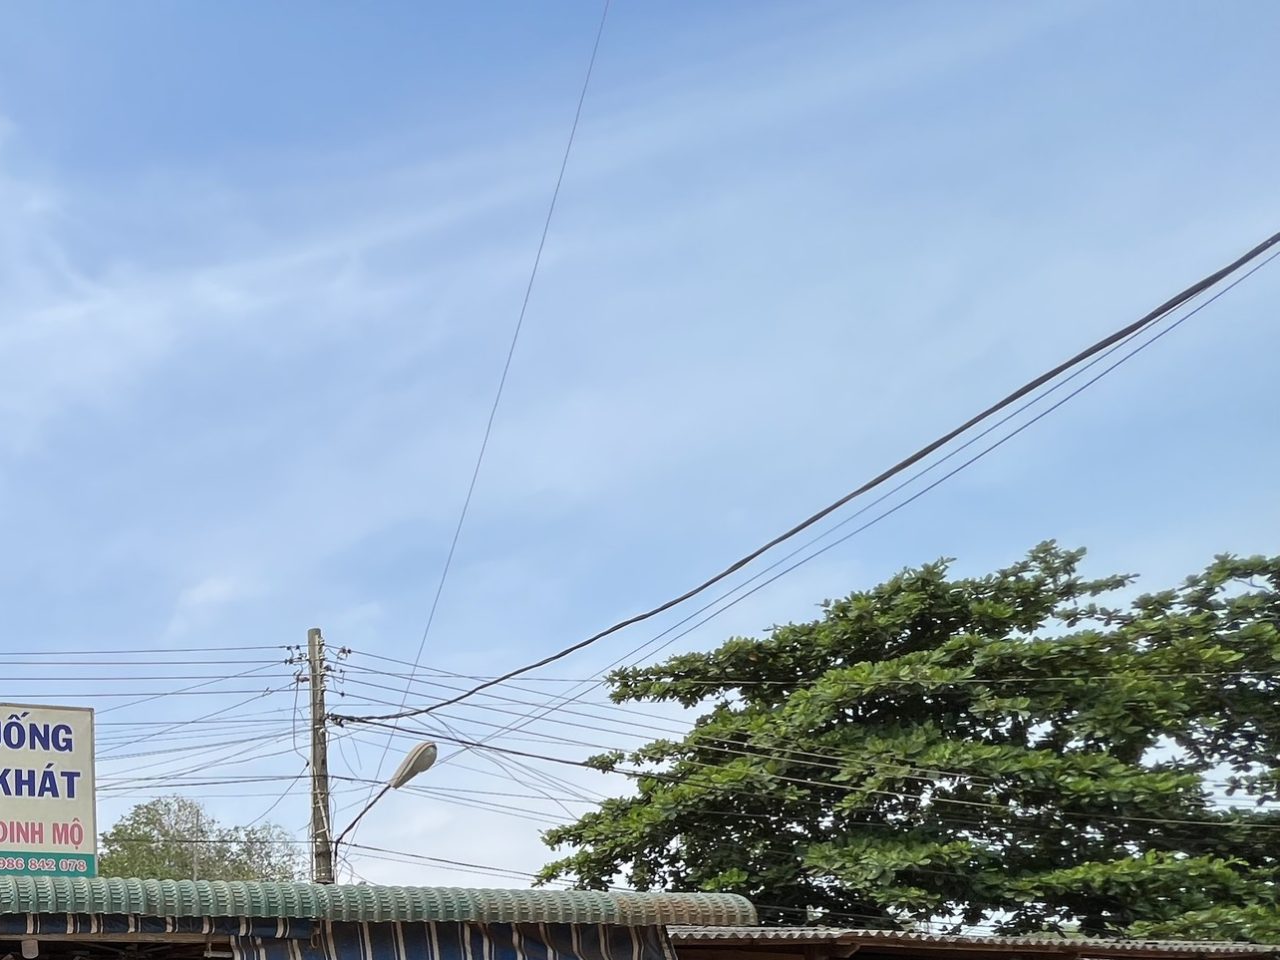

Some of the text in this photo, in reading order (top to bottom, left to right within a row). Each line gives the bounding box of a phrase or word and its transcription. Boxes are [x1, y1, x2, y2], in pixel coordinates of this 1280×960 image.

[52, 817, 84, 850] MỘ
[28, 857, 56, 872] 842
[59, 859, 87, 873] 078
